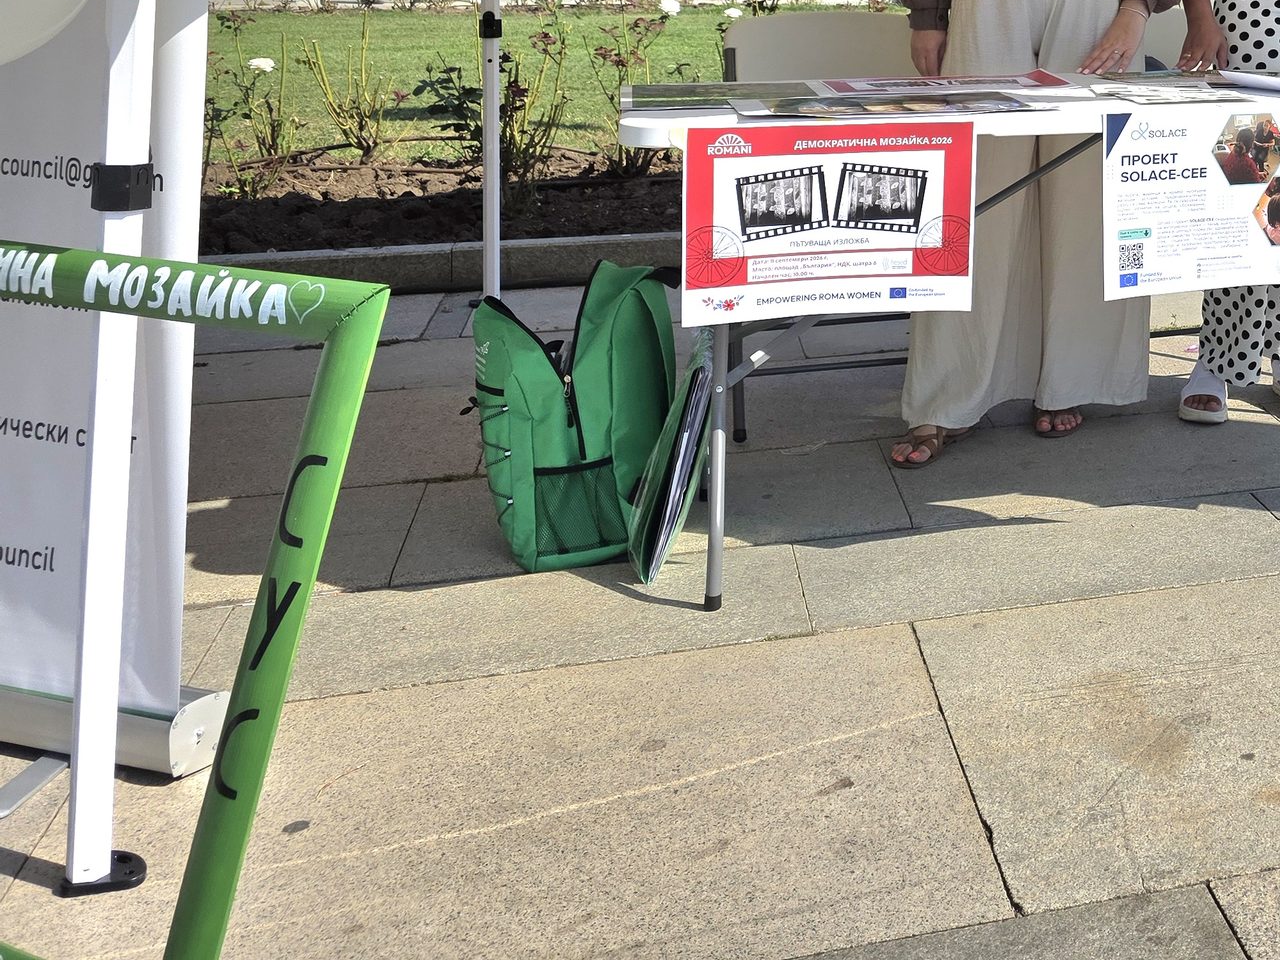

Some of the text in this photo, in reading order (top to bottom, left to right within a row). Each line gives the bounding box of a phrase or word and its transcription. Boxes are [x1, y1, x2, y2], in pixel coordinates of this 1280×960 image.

[1148, 128, 1188, 139] SOLACE
[707, 144, 752, 156] ROMANI
[793, 134, 953, 151] ДЕМОКРАТИЧНА МОЗАЙКА 2026
[1121, 152, 1178, 167] ПРОЕКТ
[1120, 167, 1208, 183] SOLACE-CEE
[789, 237, 870, 248] ПЪТУВАЩА ИЗЛОЖБА
[83, 259, 287, 325] МОЗАЙКА
[756, 291, 882, 306] EMPOWERING ROMA WOMEN
